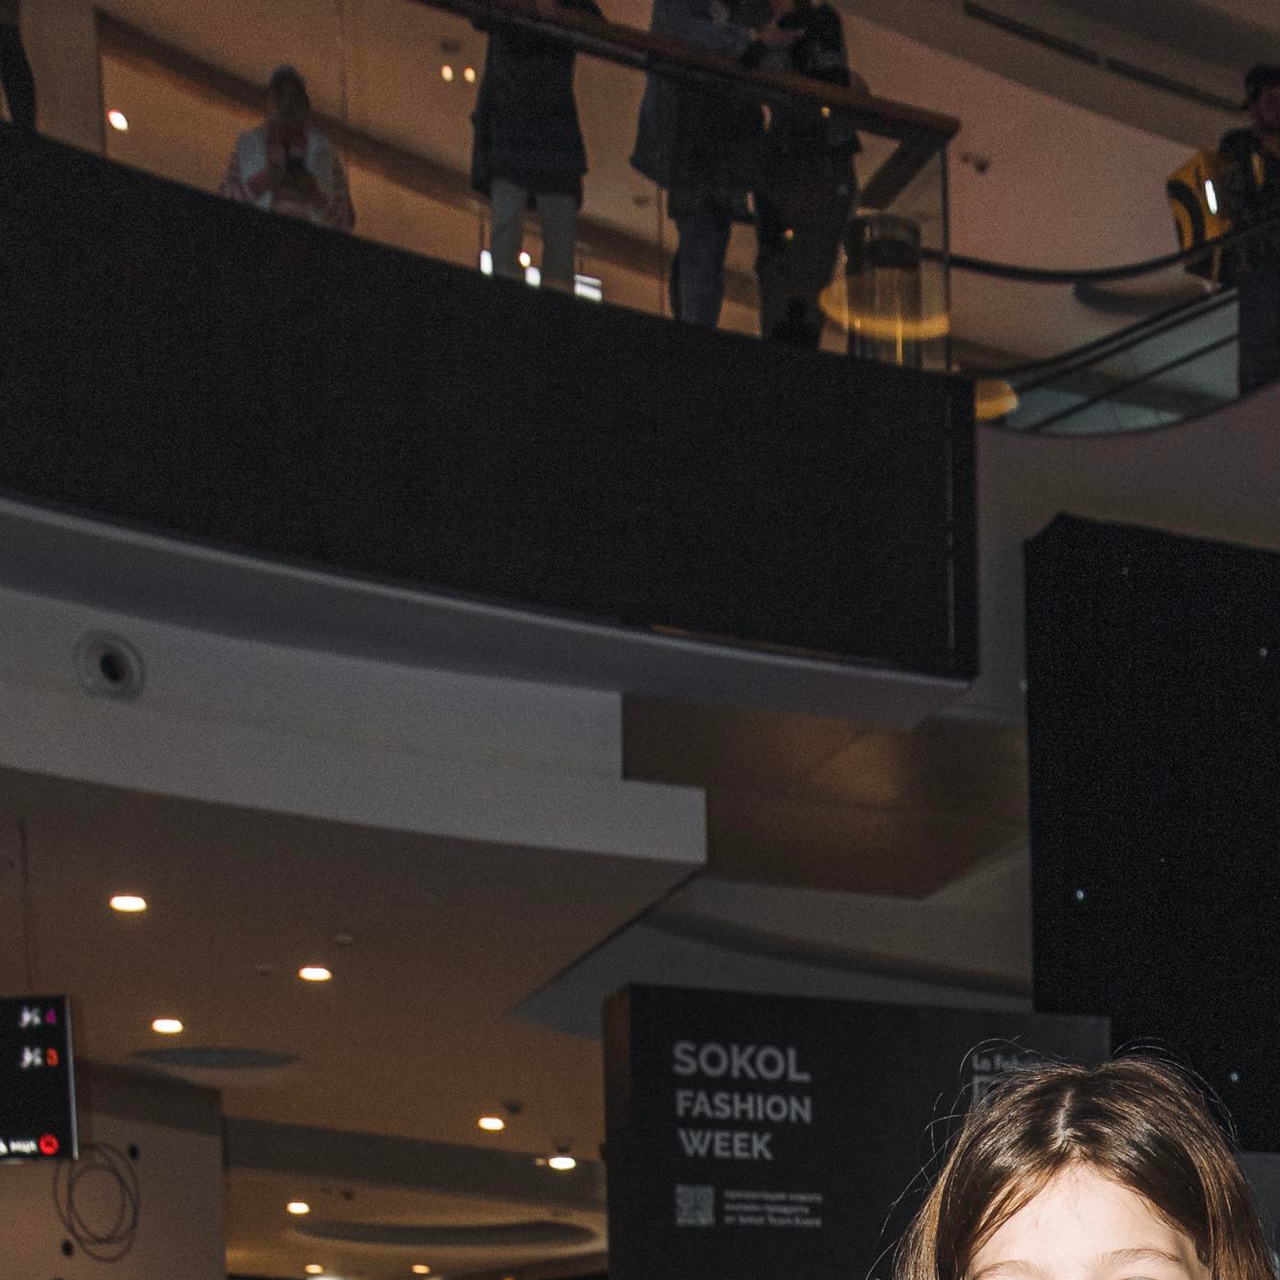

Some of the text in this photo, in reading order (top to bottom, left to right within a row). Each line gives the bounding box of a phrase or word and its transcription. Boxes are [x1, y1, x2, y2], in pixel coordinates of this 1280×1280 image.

[673, 1041, 811, 1082] SOKOL
[676, 1090, 812, 1123] FASHION
[678, 1129, 773, 1160] WEEK
